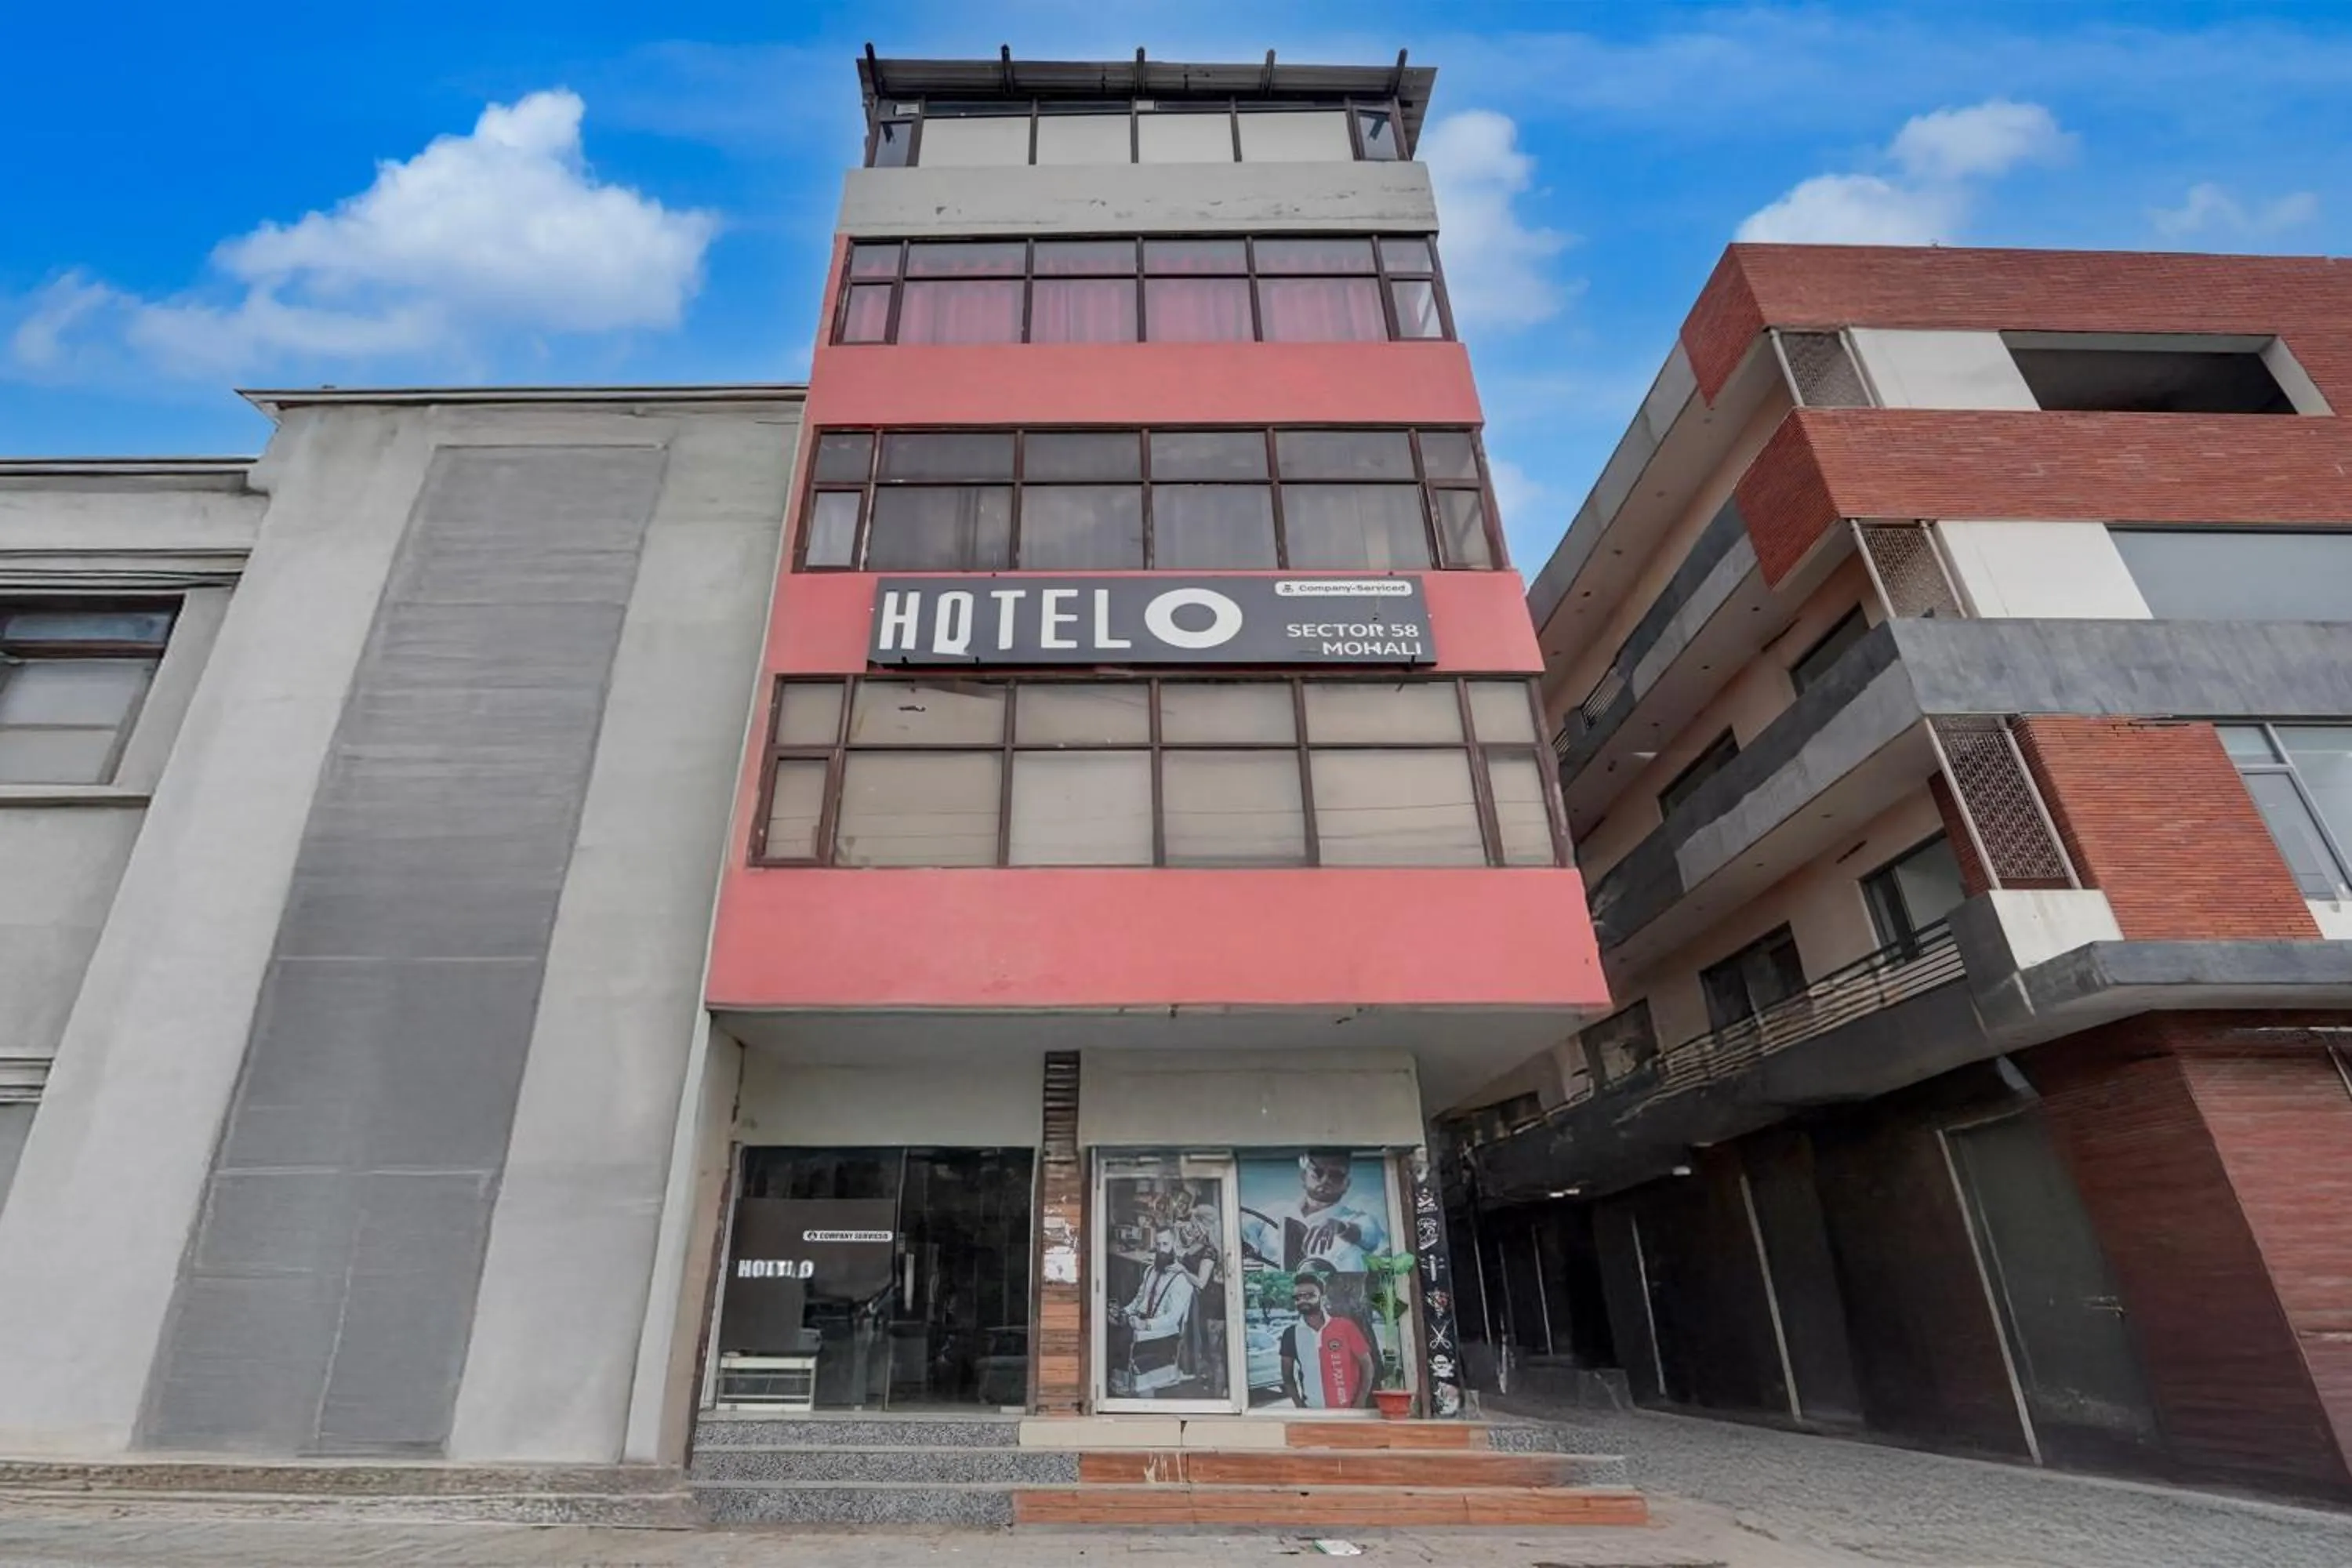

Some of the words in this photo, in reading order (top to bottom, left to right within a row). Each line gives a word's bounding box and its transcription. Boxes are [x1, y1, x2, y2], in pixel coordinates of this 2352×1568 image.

[1144, 588, 1243, 648] O
[1286, 624, 1384, 637] SECTOR
[1391, 624, 1419, 637] 58
[1322, 641, 1422, 655] MOHALI
